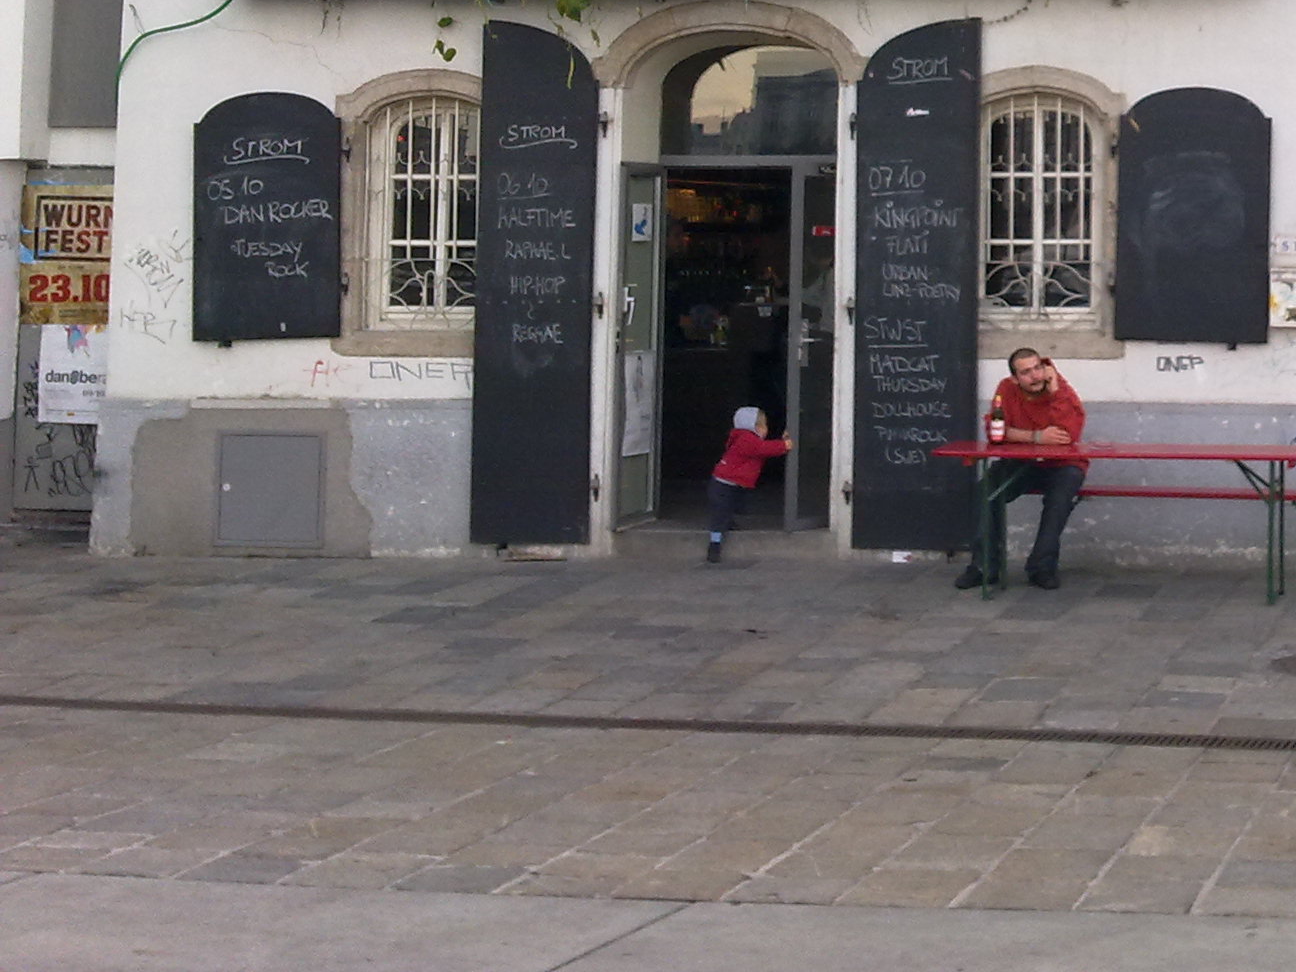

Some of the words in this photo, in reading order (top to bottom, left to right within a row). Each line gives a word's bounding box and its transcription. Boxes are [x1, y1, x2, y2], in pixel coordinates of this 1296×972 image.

[891, 55, 949, 79] STROM
[508, 125, 566, 142] STROM
[231, 137, 304, 160] STROM
[45, 230, 109, 254] FEST
